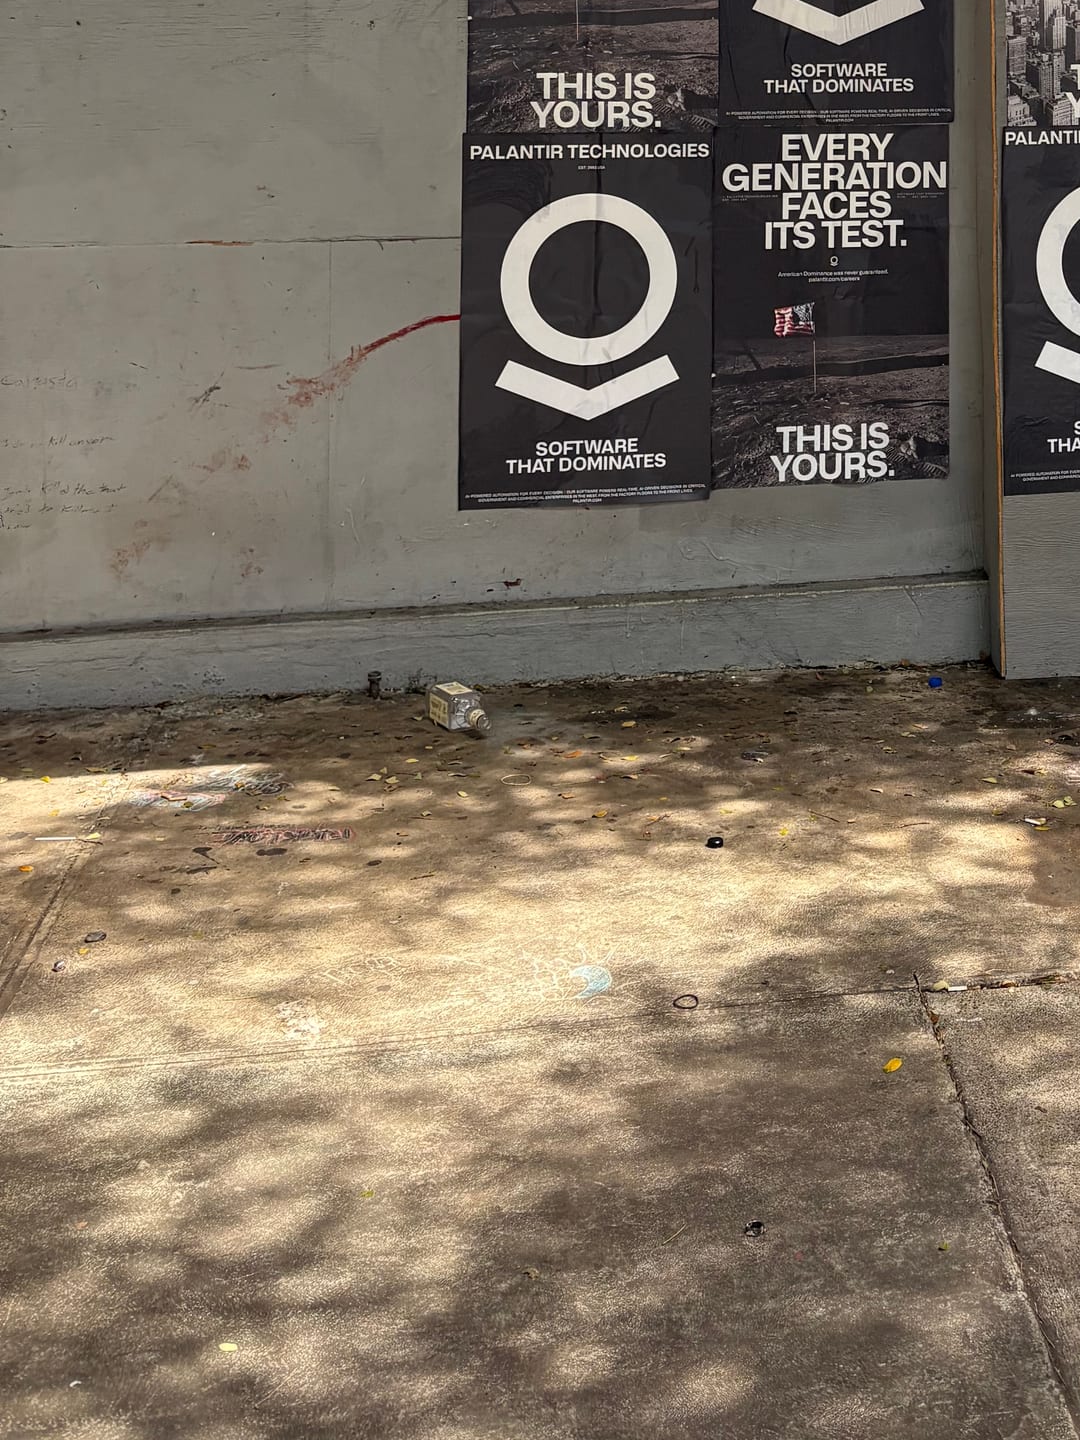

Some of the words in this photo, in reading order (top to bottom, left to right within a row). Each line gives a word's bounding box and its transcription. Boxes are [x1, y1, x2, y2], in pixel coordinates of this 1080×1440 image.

[791, 63, 887, 78] SOFTWARE
[536, 73, 616, 100] THIS
[625, 73, 656, 99] IS
[764, 79, 808, 93] THAT
[813, 78, 914, 93] DOMINATES
[530, 101, 661, 128] YOURS.
[470, 145, 563, 159] PALANTIR
[568, 144, 709, 158] TECHNOLOGIES
[782, 133, 894, 160] EVERY
[723, 161, 946, 191] GENERATION
[782, 191, 891, 219] FACES
[765, 222, 816, 249] ITS
[821, 220, 907, 248] TEST.
[536, 438, 638, 456] SOFTWARE
[776, 424, 853, 453] THIS
[861, 422, 890, 450] IS
[506, 459, 554, 474] THAT
[559, 453, 666, 472] DOMINATES
[770, 451, 894, 482] YOURS.
